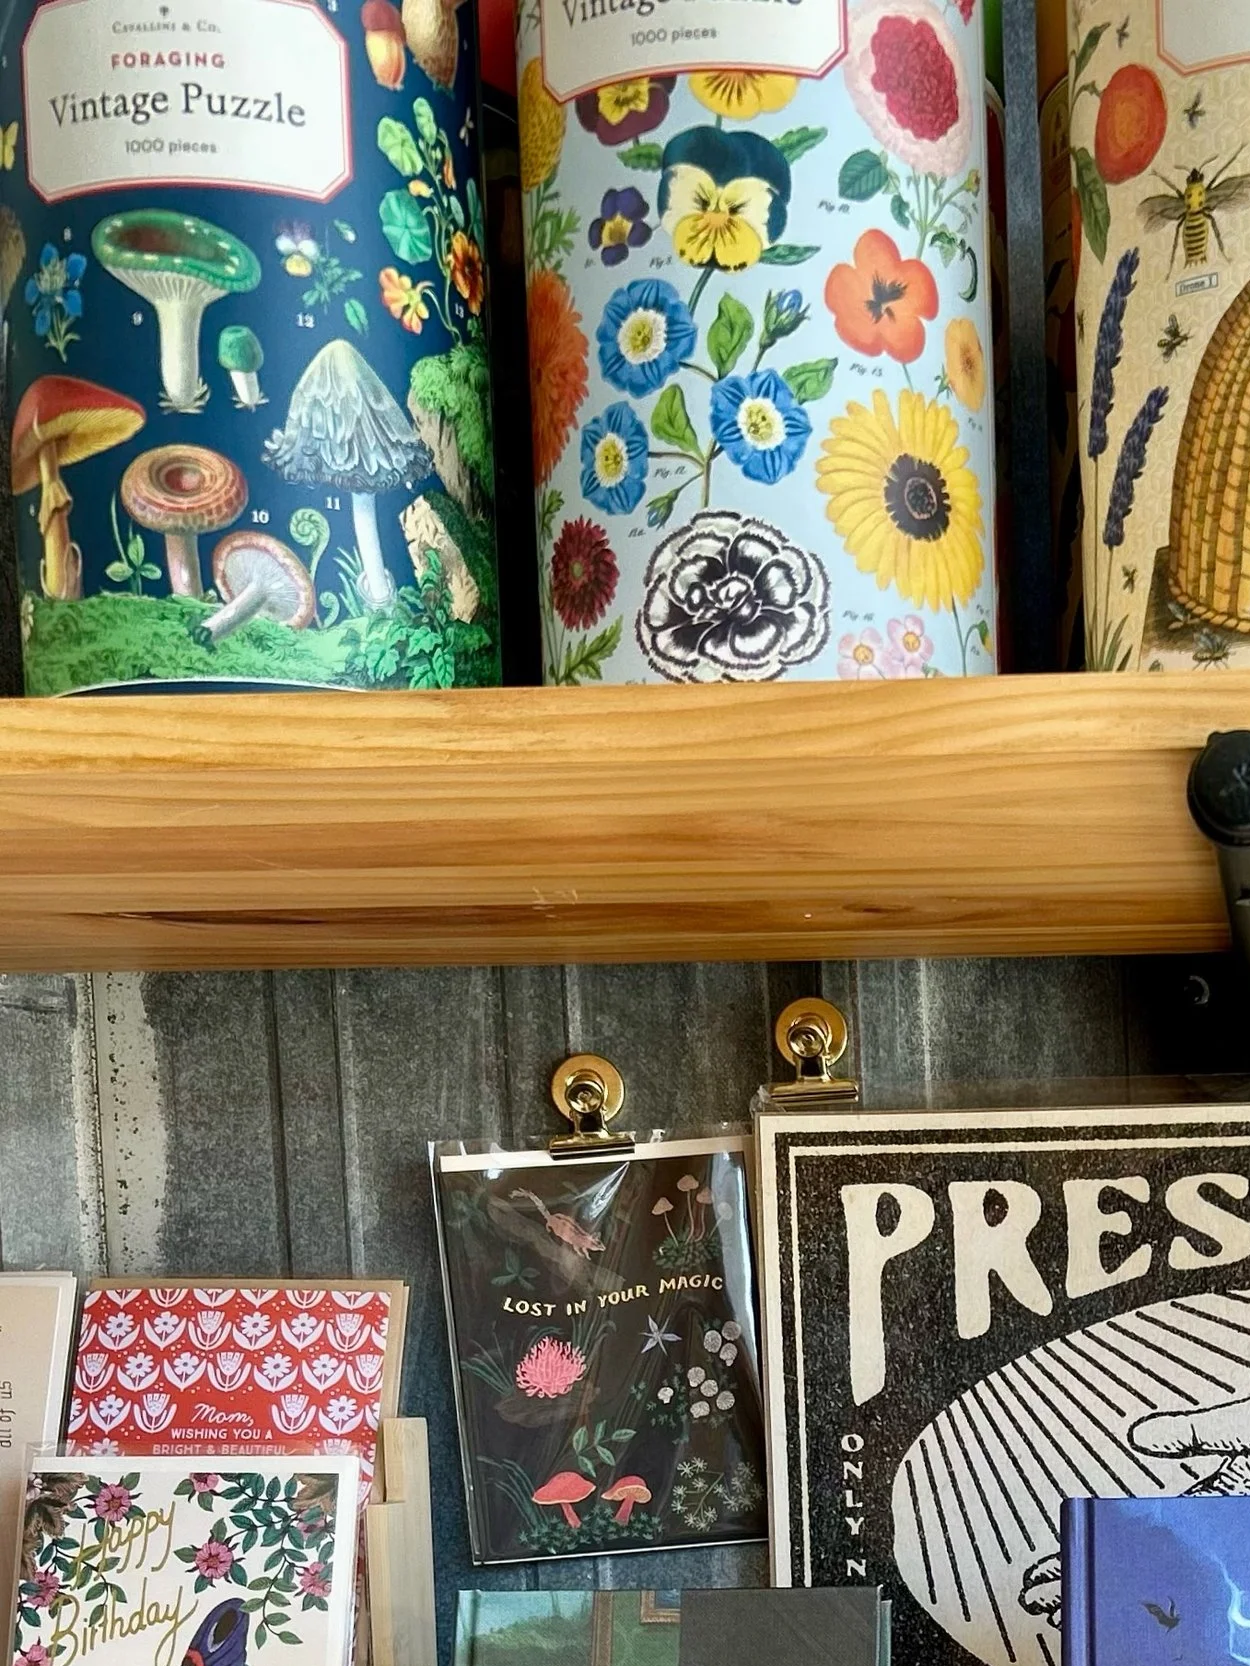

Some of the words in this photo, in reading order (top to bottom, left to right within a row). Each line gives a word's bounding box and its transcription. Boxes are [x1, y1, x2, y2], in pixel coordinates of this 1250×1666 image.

[630, 27, 667, 46] 1000
[671, 26, 718, 44] pieces
[110, 51, 226, 70] FORAGING
[48, 89, 170, 129] Vintage
[181, 82, 307, 127] Puzzle
[125, 138, 165, 154] 1000
[168, 139, 218, 155] pieces
[296, 313, 315, 328] 12
[252, 510, 270, 524] 10
[502, 1297, 557, 1318] LOST
[566, 1299, 588, 1317] IN
[597, 1284, 651, 1309] YOUR
[658, 1274, 724, 1295] MAGIC
[190, 1401, 255, 1426] Mom,
[170, 1427, 228, 1441] WISHING
[232, 1429, 262, 1441] YOU
[264, 1430, 273, 1441] A
[151, 1443, 203, 1456] BRIGHT
[205, 1443, 216, 1456] &
[219, 1442, 288, 1456] BEAUTIFUL
[840, 1432, 866, 1536] ONLY
[70, 1500, 177, 1591] Happy
